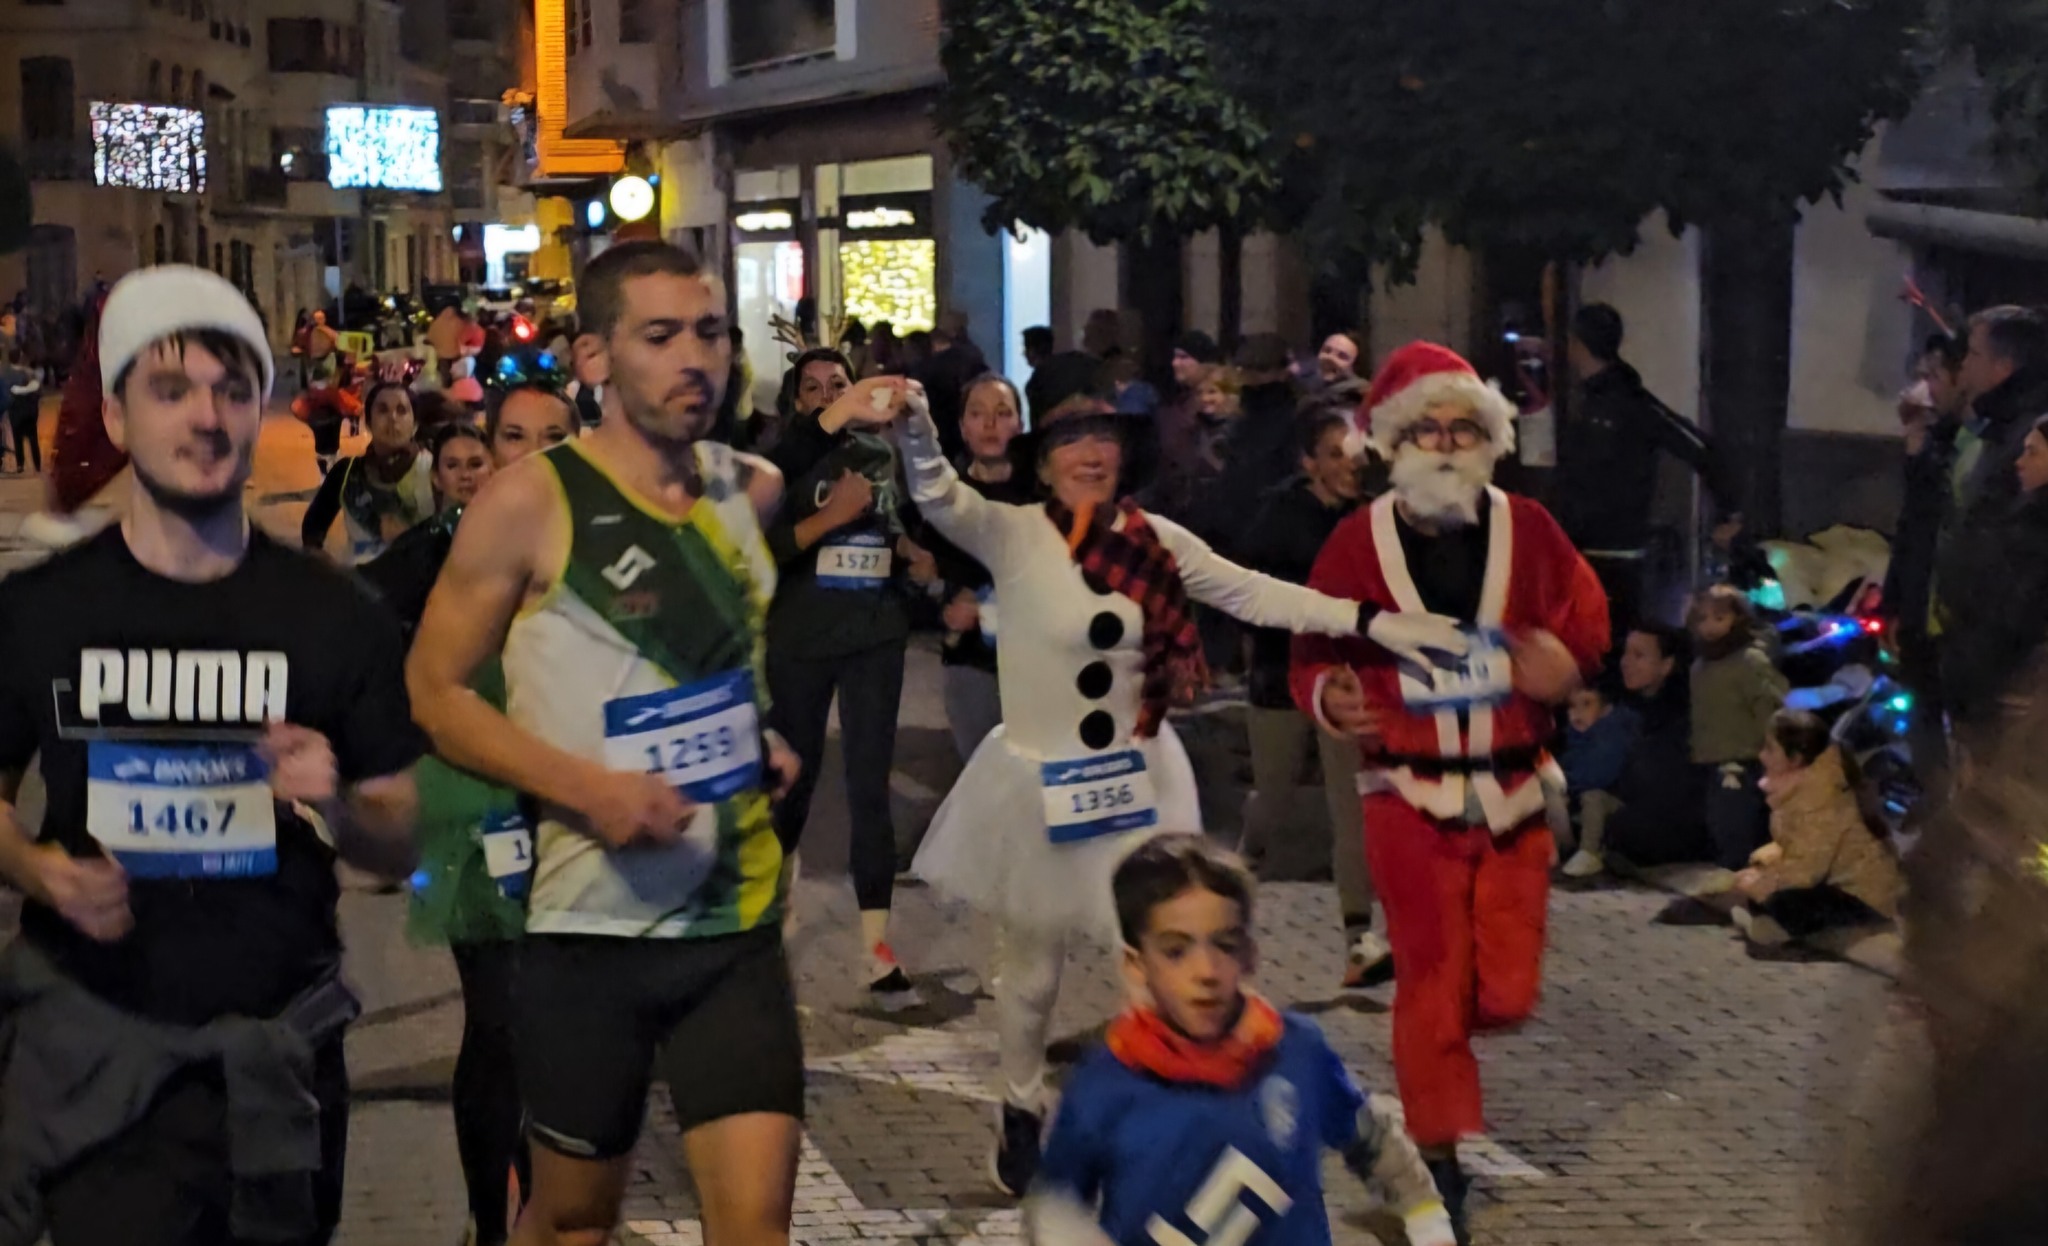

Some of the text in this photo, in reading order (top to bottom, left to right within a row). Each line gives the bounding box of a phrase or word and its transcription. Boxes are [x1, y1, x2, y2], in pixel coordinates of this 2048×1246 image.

[834, 553, 880, 570] 1527
[80, 648, 288, 723] PUMA
[1071, 783, 1134, 814] 1356
[128, 799, 236, 836] 1467
